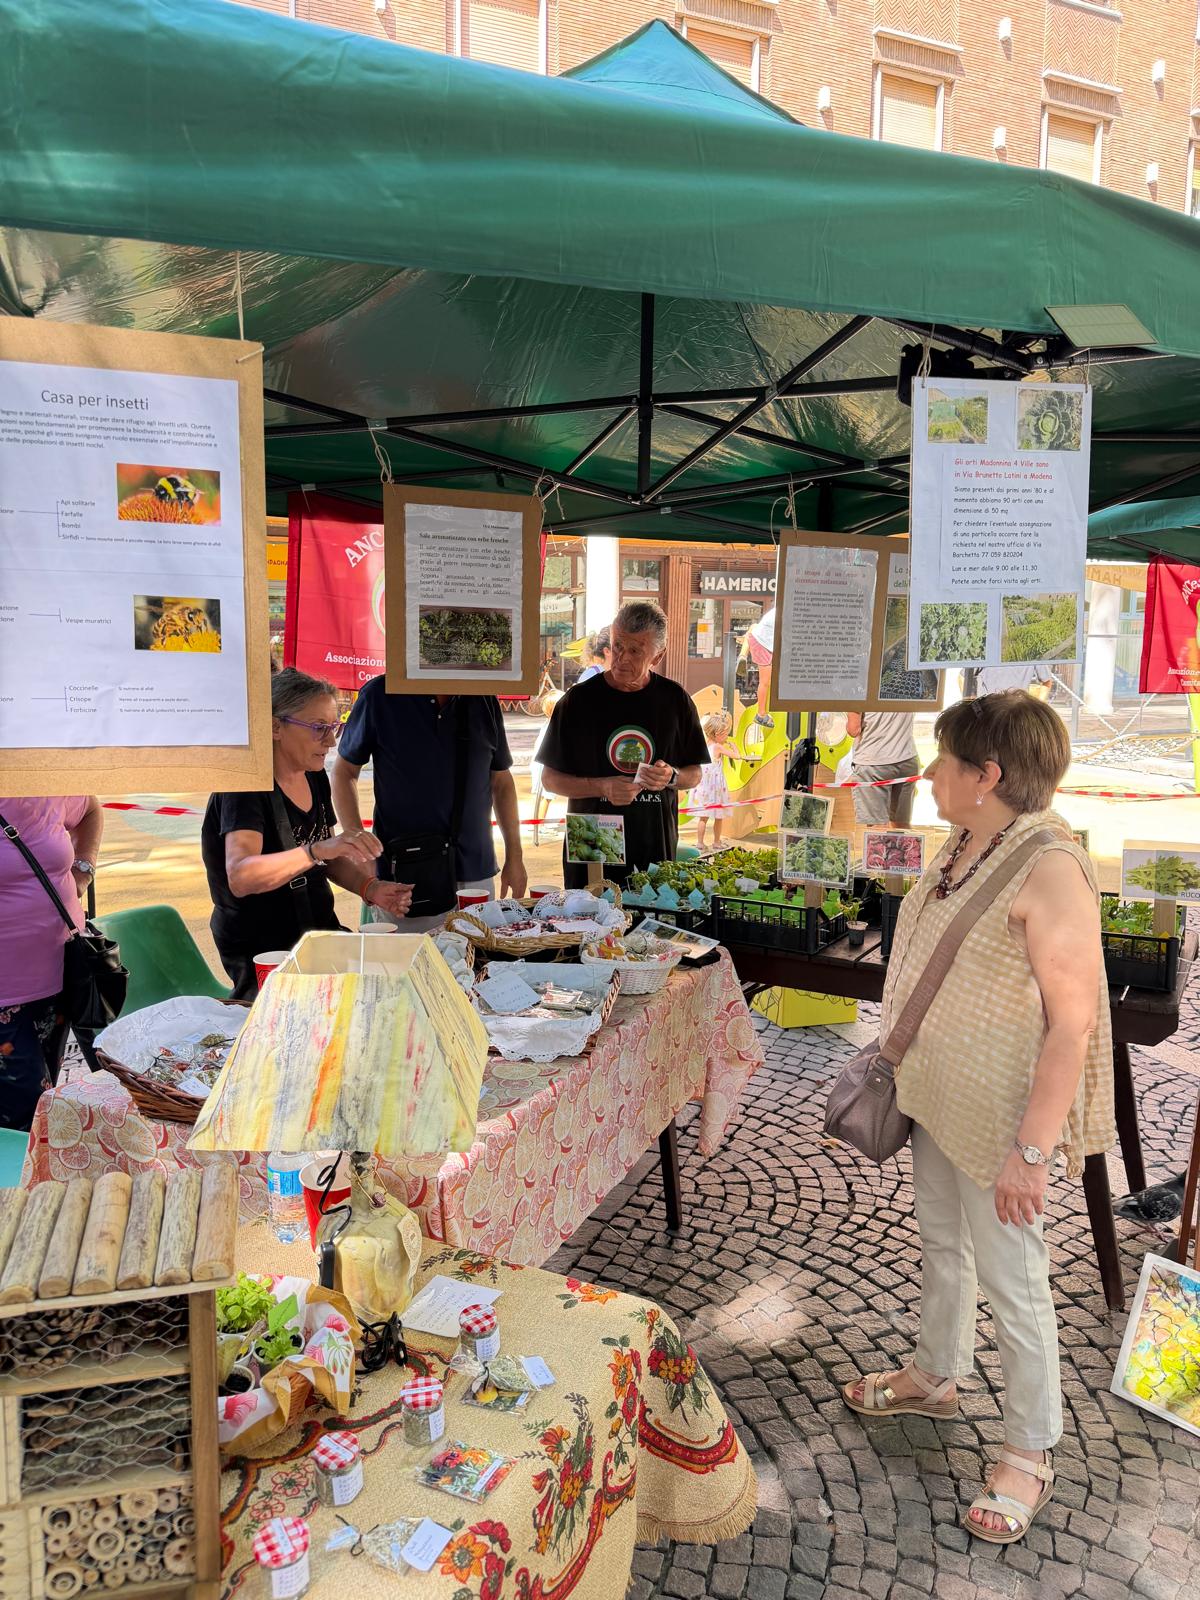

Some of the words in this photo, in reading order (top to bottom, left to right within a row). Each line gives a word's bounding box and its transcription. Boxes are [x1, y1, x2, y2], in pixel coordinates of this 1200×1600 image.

[41, 389, 74, 404] Casa
[79, 395, 102, 408] per
[106, 395, 149, 411] insetti
[954, 458, 963, 467] Gli
[965, 459, 978, 467] orti
[979, 459, 1012, 468] Madonnina
[1020, 461, 1034, 469] Ville
[962, 471, 973, 479] Via
[975, 471, 1003, 479] Brunetto
[1004, 472, 1022, 480] Latini
[1030, 473, 1053, 481] Modena
[972, 486, 995, 495] presenti
[996, 486, 1005, 494] dai
[1006, 487, 1020, 496] primi
[979, 497, 1002, 505] abbiamo
[1003, 497, 1011, 505] 90
[953, 507, 983, 515] dimensione
[953, 519, 962, 527] Per
[964, 520, 988, 528] chiedere
[1019, 522, 1053, 530] assegnazione
[971, 531, 998, 540] particella
[1033, 531, 1040, 539] la
[1006, 541, 1025, 549] ufficio
[952, 551, 981, 559] Barchetta
[981, 551, 989, 559] 77
[991, 551, 1001, 559] 059
[1003, 551, 1024, 559] 820204
[981, 564, 994, 572] dalle
[65, 617, 83, 625] Vespe
[84, 617, 112, 625] muratrici
[639, 793, 662, 803] A.P.S.
